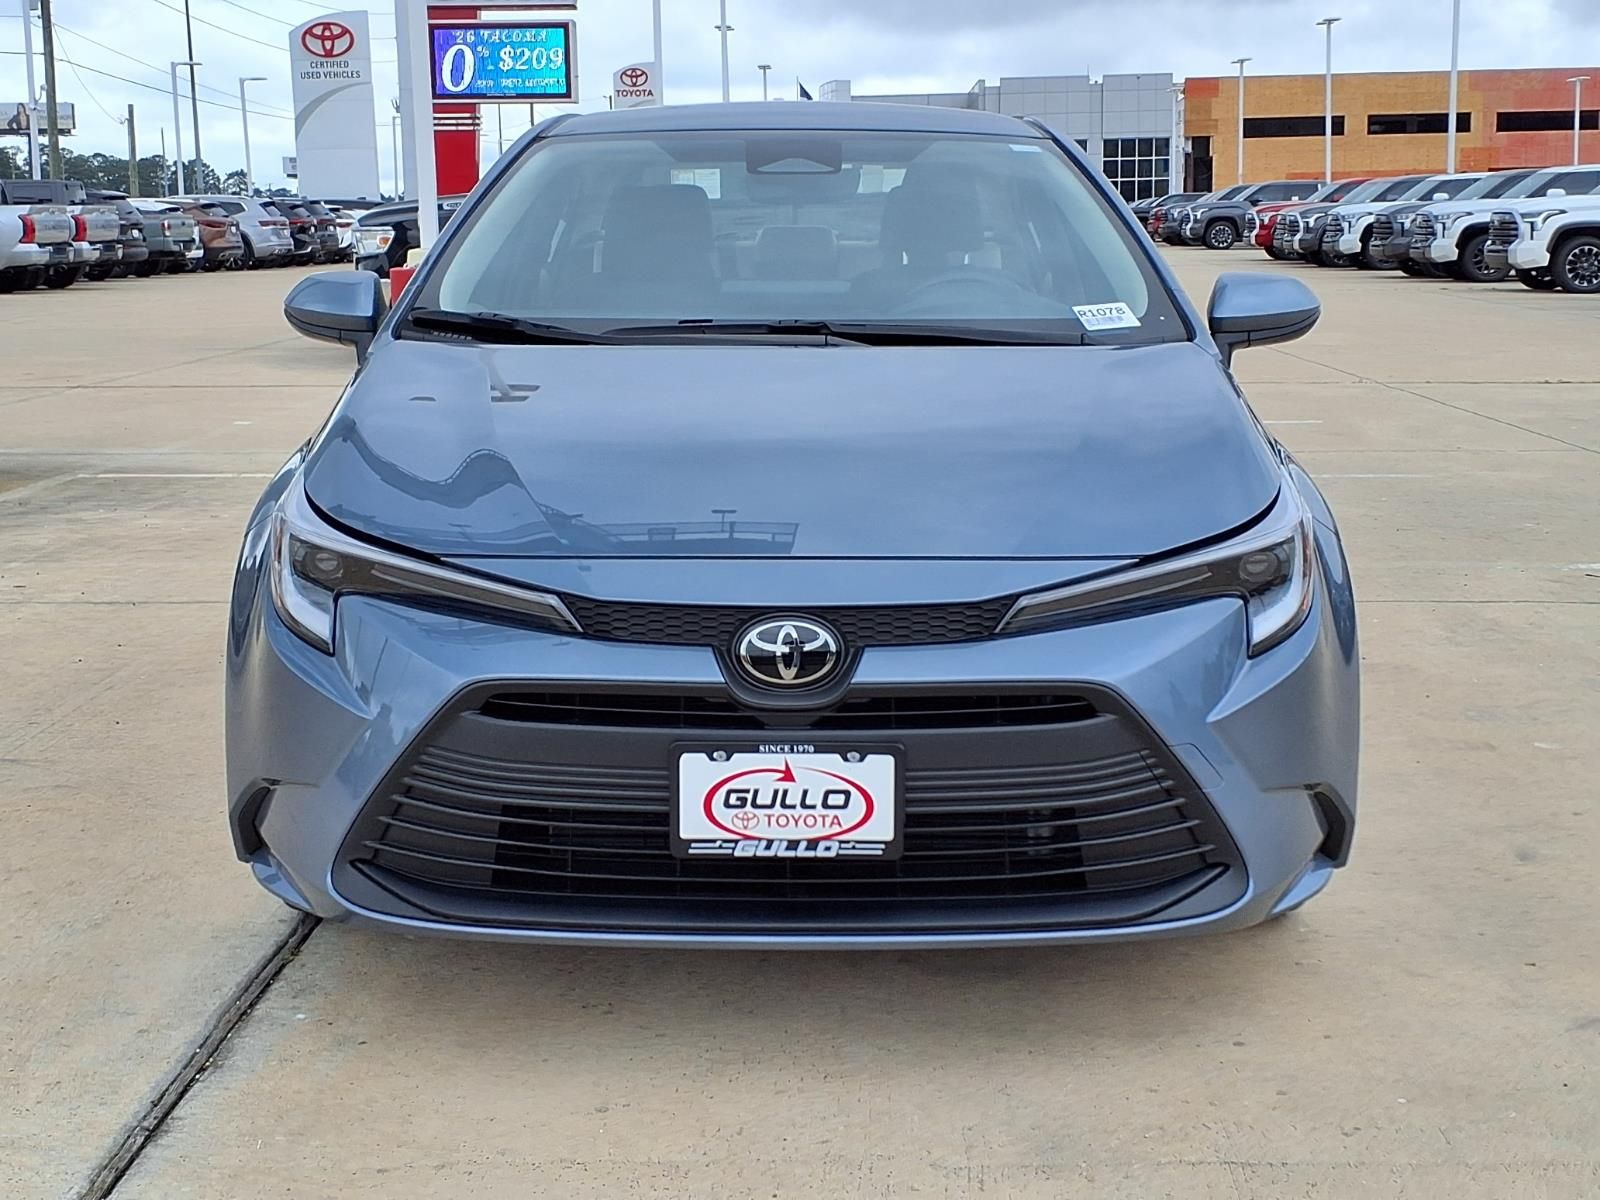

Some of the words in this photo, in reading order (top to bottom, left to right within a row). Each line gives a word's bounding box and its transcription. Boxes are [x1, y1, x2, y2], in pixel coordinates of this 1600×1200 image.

[499, 44, 564, 72] $209
[310, 60, 350, 69] CERTIFIED
[300, 71, 321, 80] USED
[322, 70, 361, 79] VEHICLES
[615, 89, 654, 98] TOYOTA
[1077, 306, 1126, 318] R1078
[758, 744, 791, 753] SINCE
[793, 744, 815, 753] 1970
[723, 788, 852, 810] GULLO
[764, 814, 843, 829] TOYOTA
[733, 839, 841, 858] GULLO
